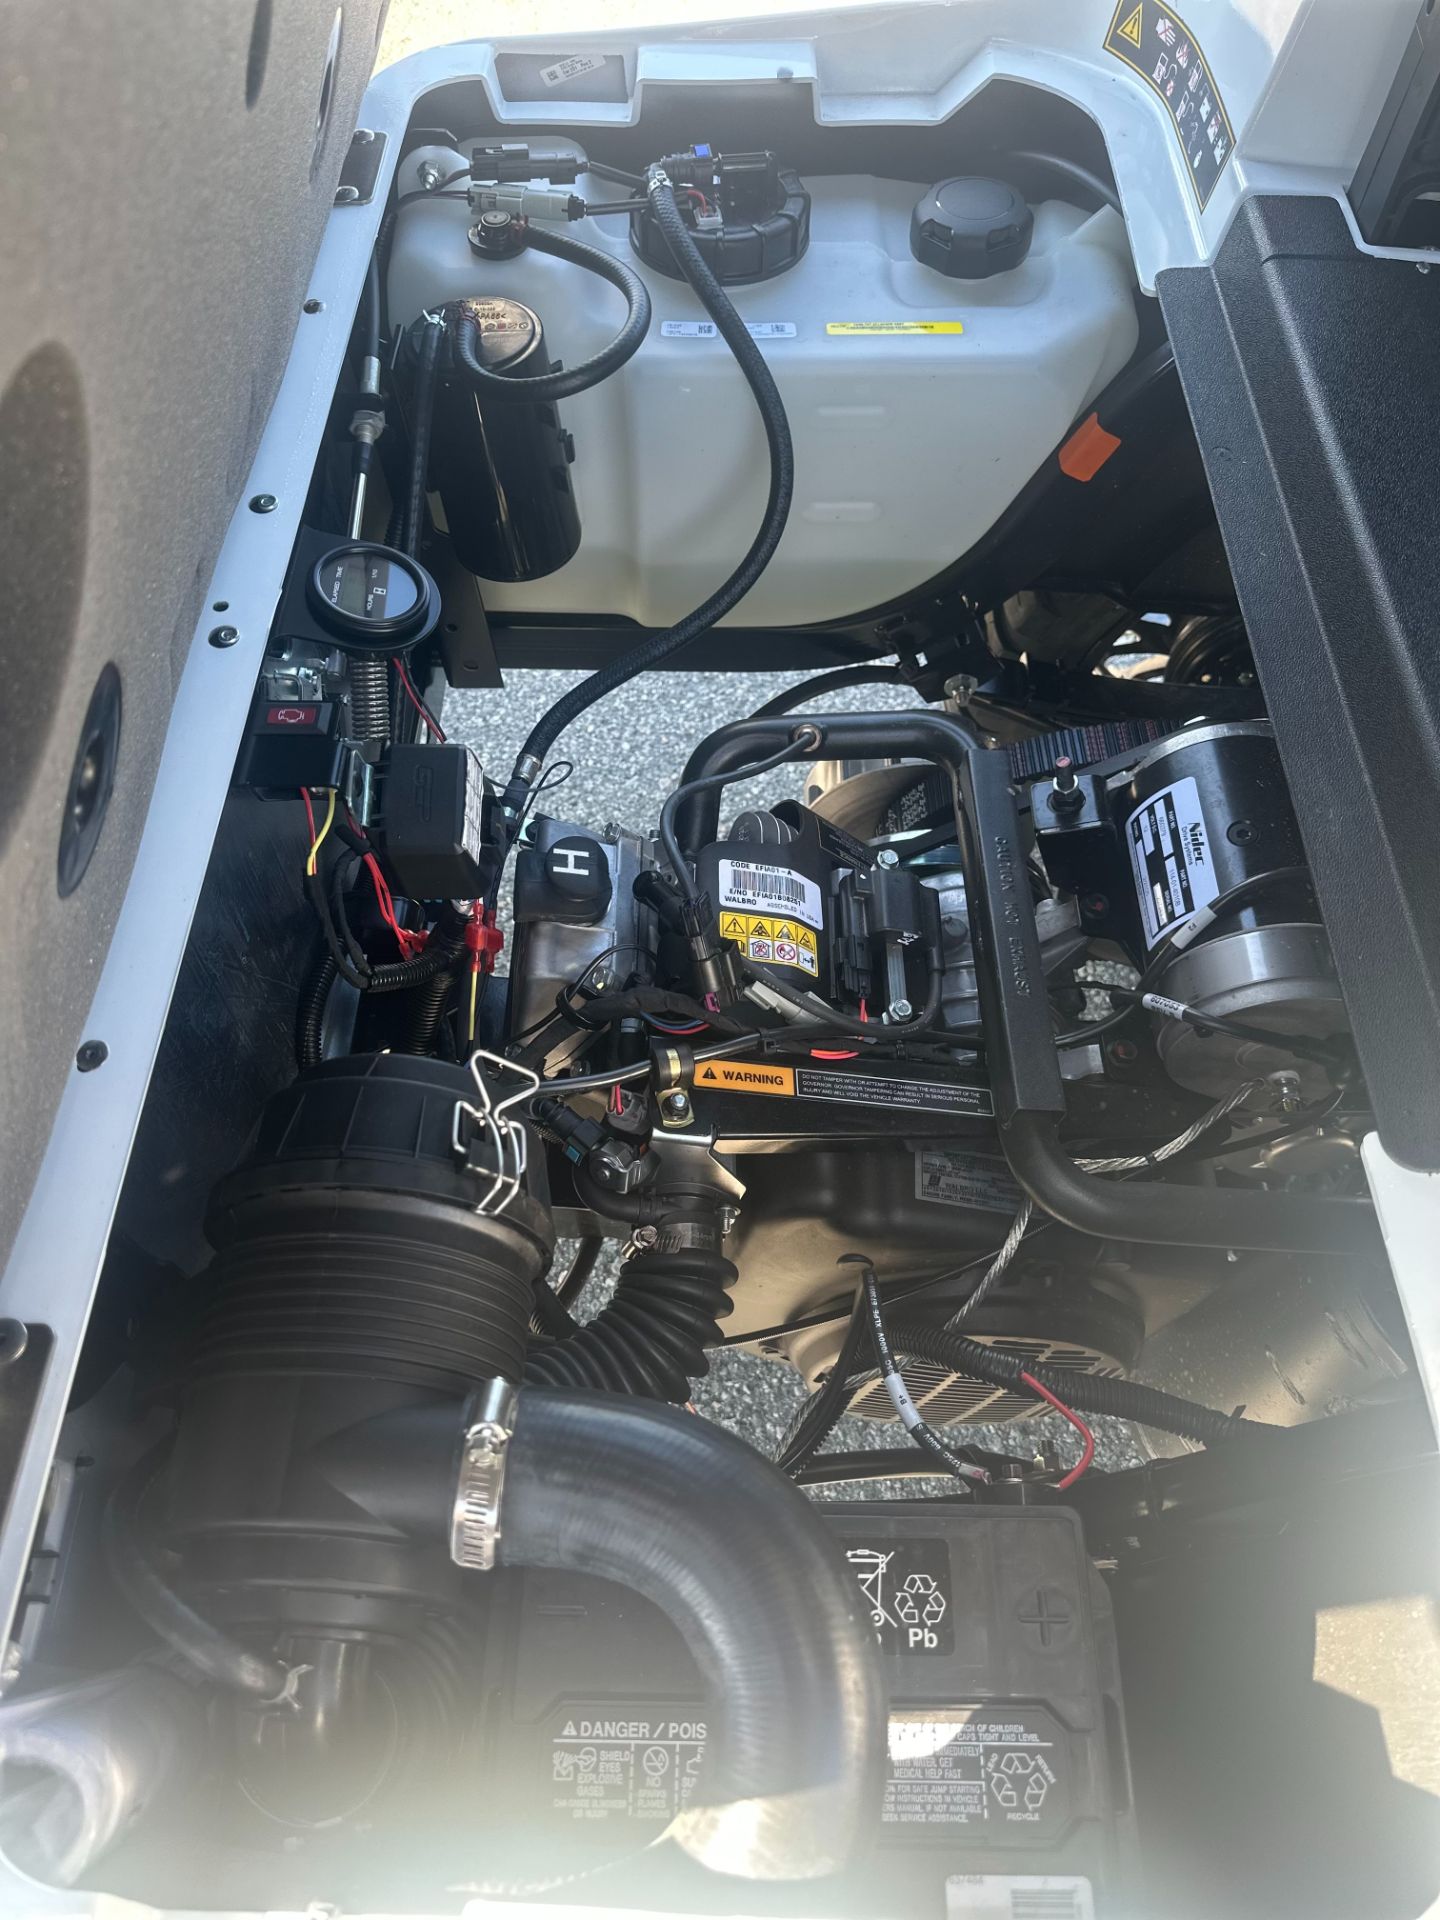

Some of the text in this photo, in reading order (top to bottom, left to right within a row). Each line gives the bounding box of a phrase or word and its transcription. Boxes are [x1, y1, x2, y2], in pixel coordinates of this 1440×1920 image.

[331, 566, 344, 603] ELAPSED TIME
[366, 594, 374, 611] HOURS
[1181, 826, 1193, 866] Drive Systems
[1188, 822, 1205, 866] Nidec
[730, 860, 750, 870] CODE
[729, 888, 748, 897] E/NO
[724, 895, 757, 906] WALBRO
[722, 1070, 784, 1087] WARNING
[833, 1083, 863, 1091] GOVERNOR
[929, 1087, 961, 1095] ADJUSTMENT
[873, 1308, 882, 1328] XLPE
[908, 1627, 939, 1649] Pb
[580, 1721, 650, 1738] DANGER
[988, 1724, 1024, 1733] CHILDREN
[978, 1733, 999, 1742] TIGHT
[1001, 1733, 1017, 1742] AND
[1018, 1733, 1040, 1742] LEVEL
[600, 1750, 631, 1762] SHIELD
[599, 1762, 622, 1773] EYES
[939, 1757, 954, 1768] GET
[986, 1752, 998, 1773] LEAD
[893, 1768, 962, 1779] MEDICAL HELP FAST
[1034, 1753, 1057, 1785] RETURN
[577, 1773, 624, 1785] EXPLOSIVE
[645, 1776, 662, 1788] NO
[576, 1785, 605, 1797] GASES
[897, 1784, 911, 1793] FOR
[912, 1784, 928, 1793] SAFE
[930, 1784, 947, 1794] JUMP
[948, 1784, 980, 1794] STARTING
[896, 1794, 943, 1804] INSTRUCTIONS
[952, 1794, 978, 1804] VEHICLE
[933, 1804, 948, 1813] NOT
[948, 1804, 982, 1814] AVAILABLE
[899, 1812, 926, 1822] SERVICE
[1006, 1812, 1040, 1821] RECYCLE
